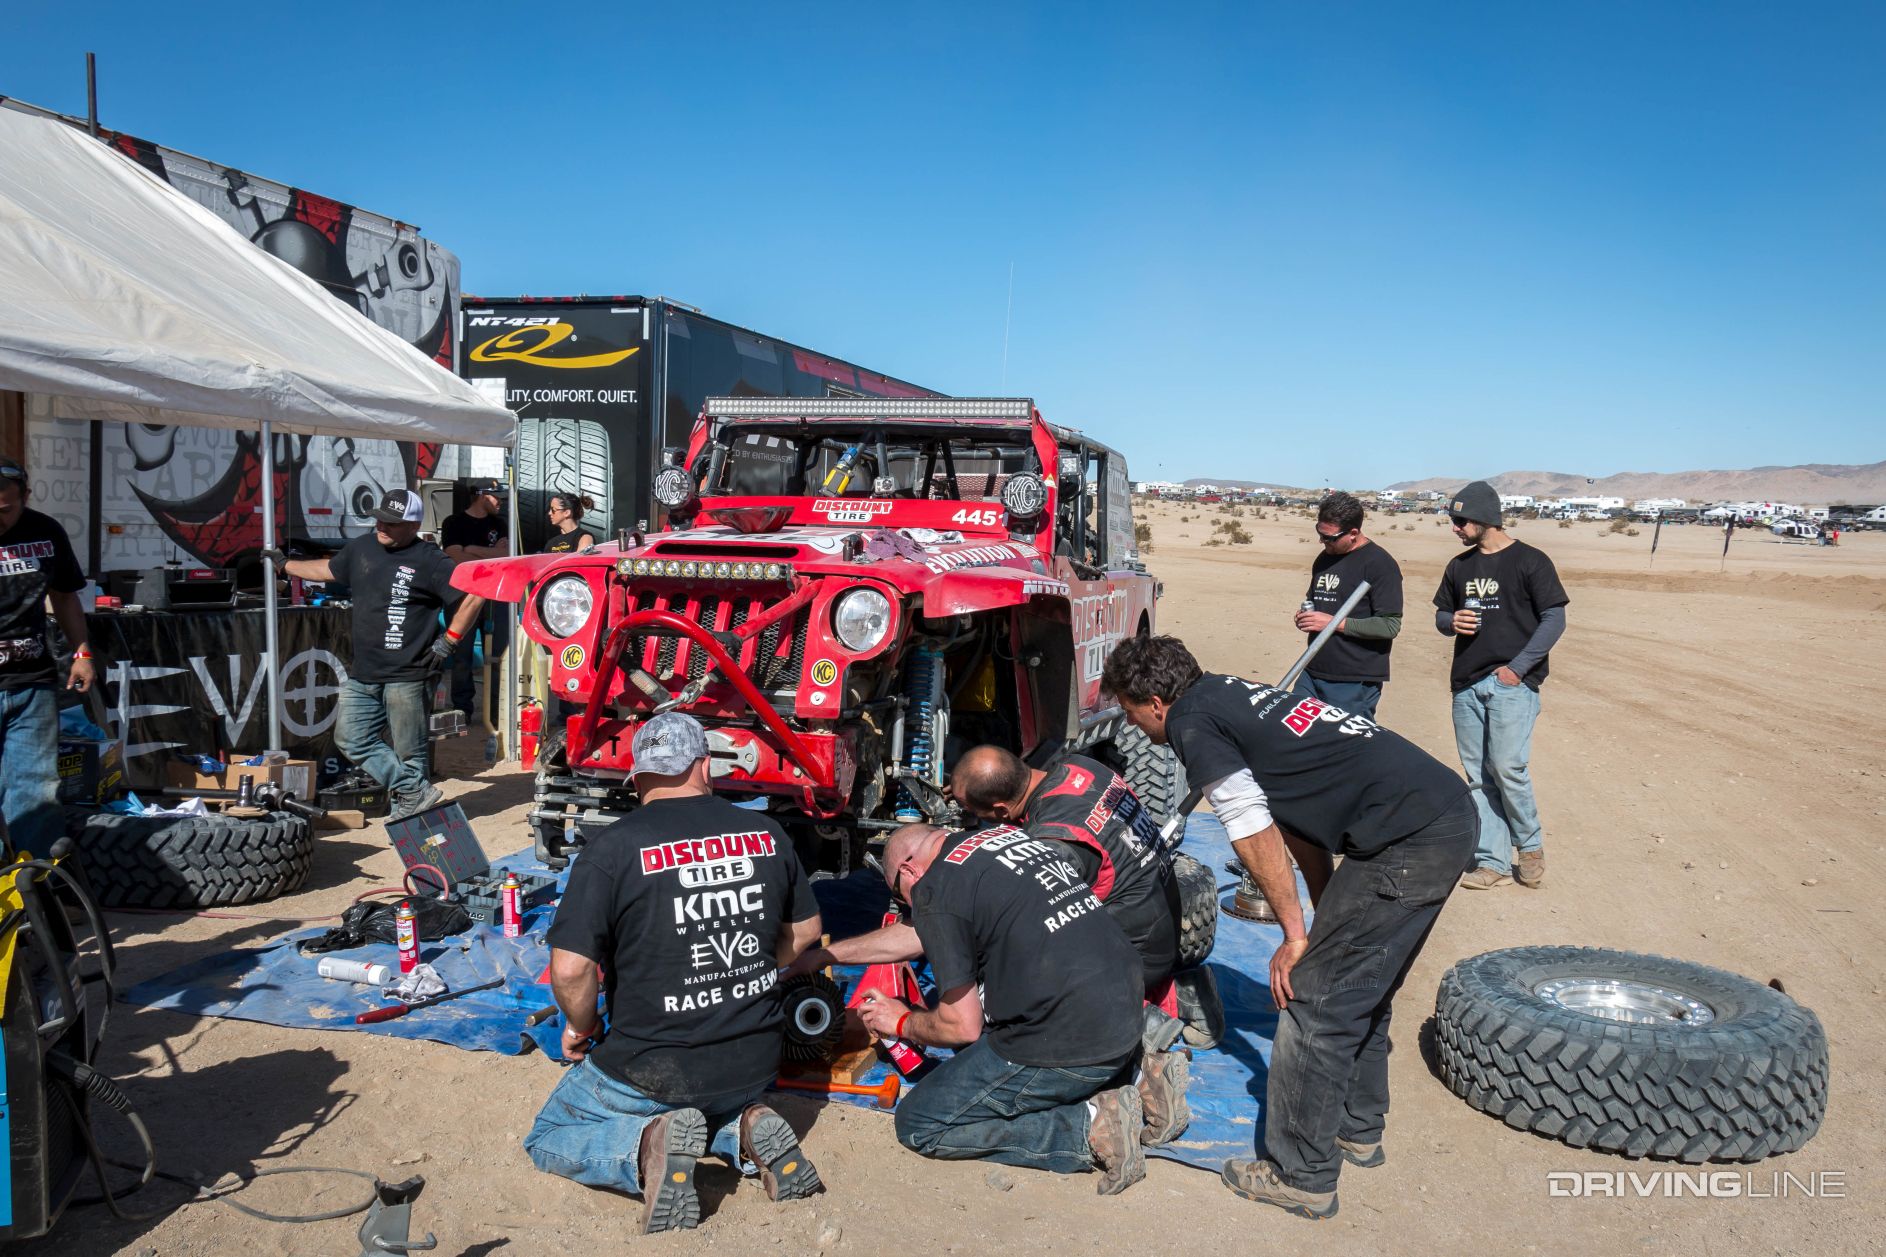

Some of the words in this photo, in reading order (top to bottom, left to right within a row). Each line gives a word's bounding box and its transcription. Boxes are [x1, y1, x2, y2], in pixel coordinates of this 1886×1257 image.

[469, 317, 560, 326] NT421
[533, 389, 595, 402] COMFORT.
[597, 389, 638, 403] QUIET.
[655, 470, 681, 506] KC
[1007, 477, 1037, 514] KC
[812, 499, 892, 514] DISCOUNT
[832, 512, 868, 521] TIRE
[926, 544, 1017, 575] EVOLUTION
[1023, 580, 1070, 595] NITTO
[1317, 573, 1340, 591] EVO
[1465, 577, 1499, 599] EVO
[1073, 589, 1127, 649] DISCOUNT
[565, 648, 581, 666] KC
[814, 663, 835, 682] KC
[106, 647, 348, 770] EVO
[983, 831, 1027, 848] TIRE
[640, 830, 777, 876] DISCOUNT
[684, 860, 748, 886] TIRE
[1034, 859, 1079, 892] EVO
[673, 884, 764, 925] KMC
[1044, 901, 1087, 933] RACE
[676, 912, 766, 935] WHEELS
[690, 930, 760, 970] EVO
[684, 960, 766, 986] MANUFACTURING
[664, 986, 724, 1013] RACE
[732, 967, 779, 1000] CREW
